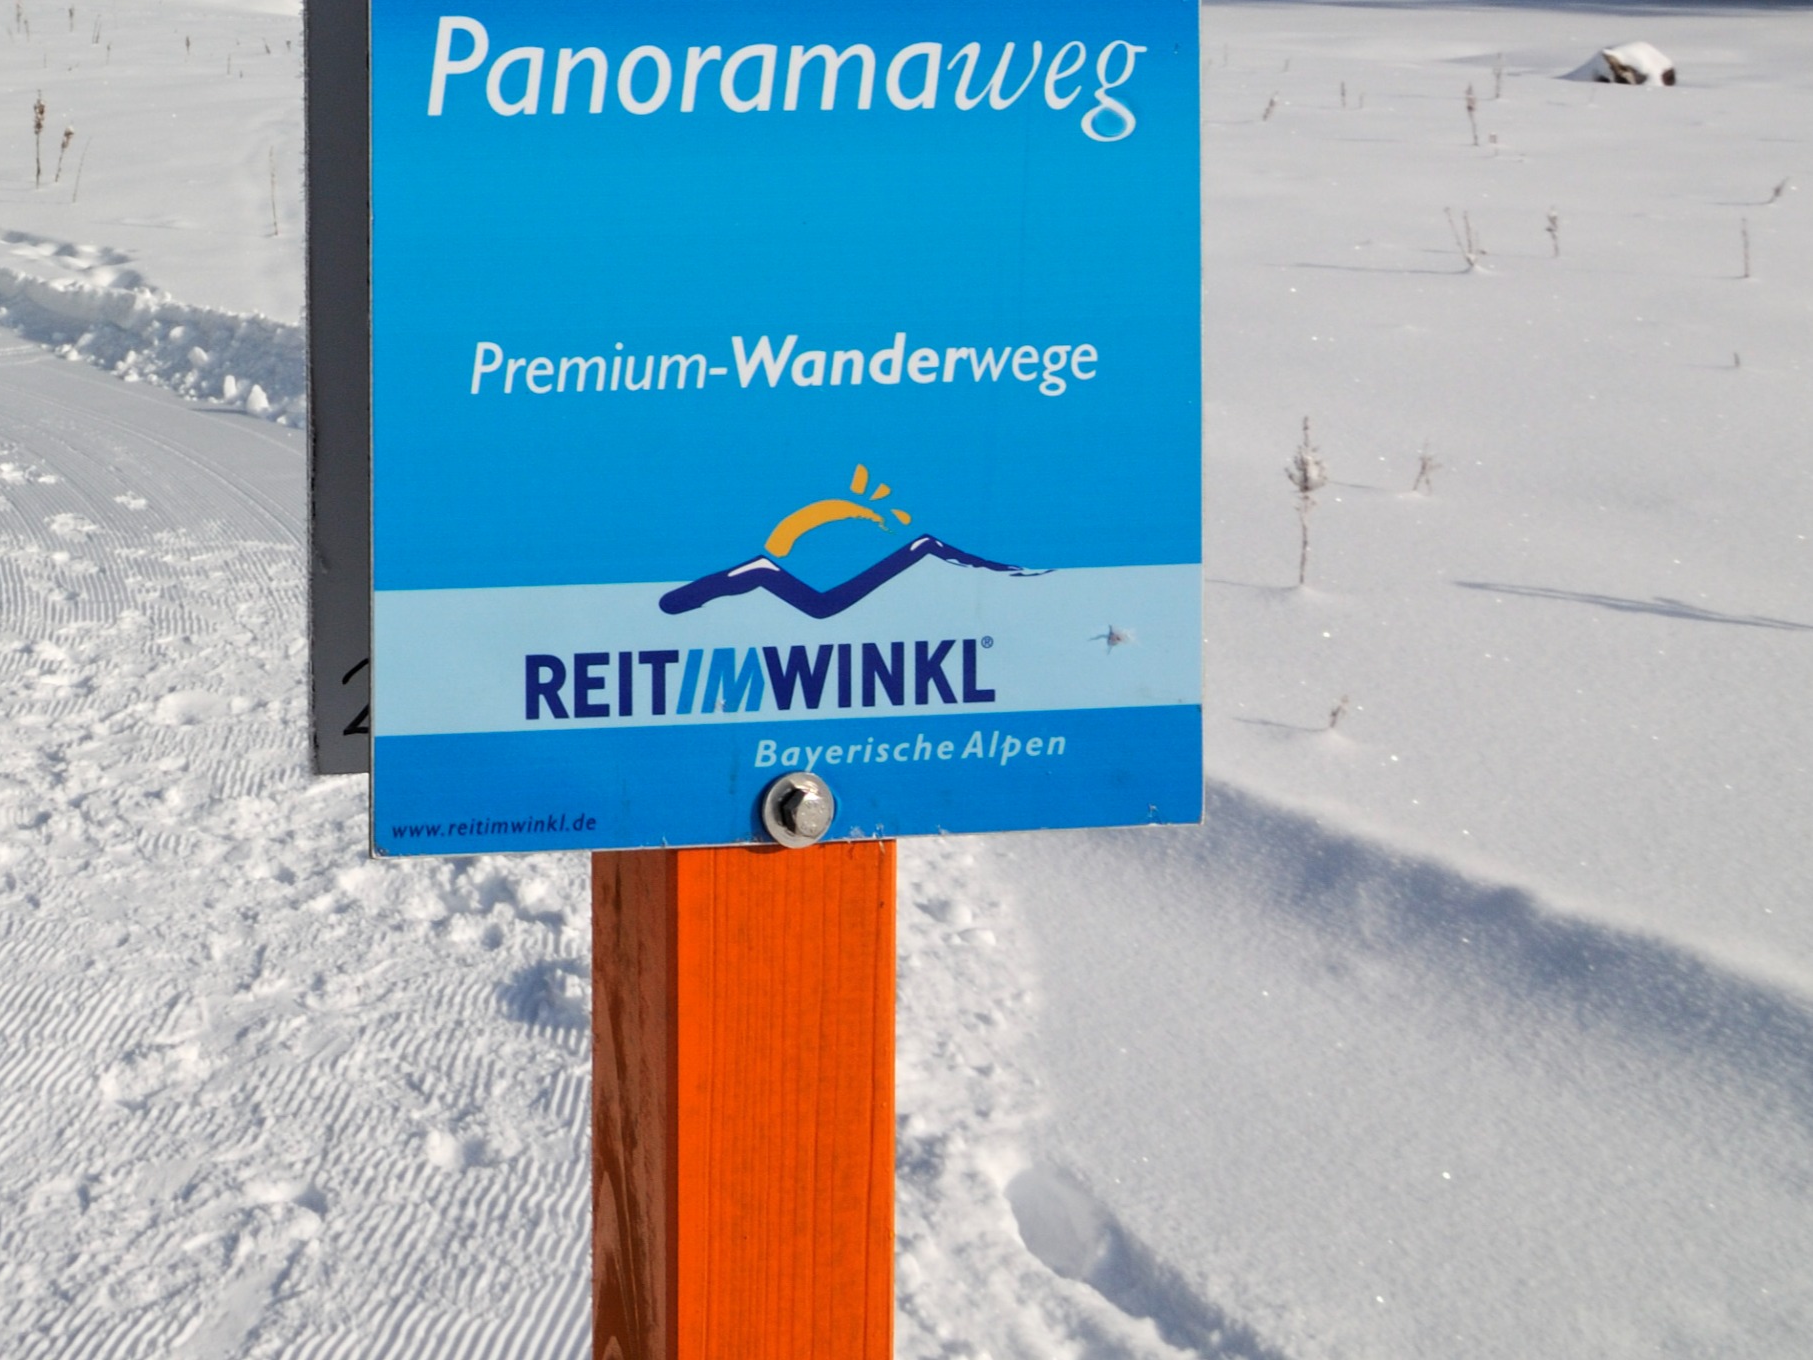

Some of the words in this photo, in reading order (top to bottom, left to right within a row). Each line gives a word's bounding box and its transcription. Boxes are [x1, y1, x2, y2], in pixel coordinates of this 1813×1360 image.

[426, 14, 1148, 143] Panoramaweg
[469, 331, 1099, 397] Premium-Wanderwege
[753, 736, 955, 772] Bayerische
[960, 729, 1067, 767] Alpen
[391, 812, 597, 839] www.reitimwinkl.de
